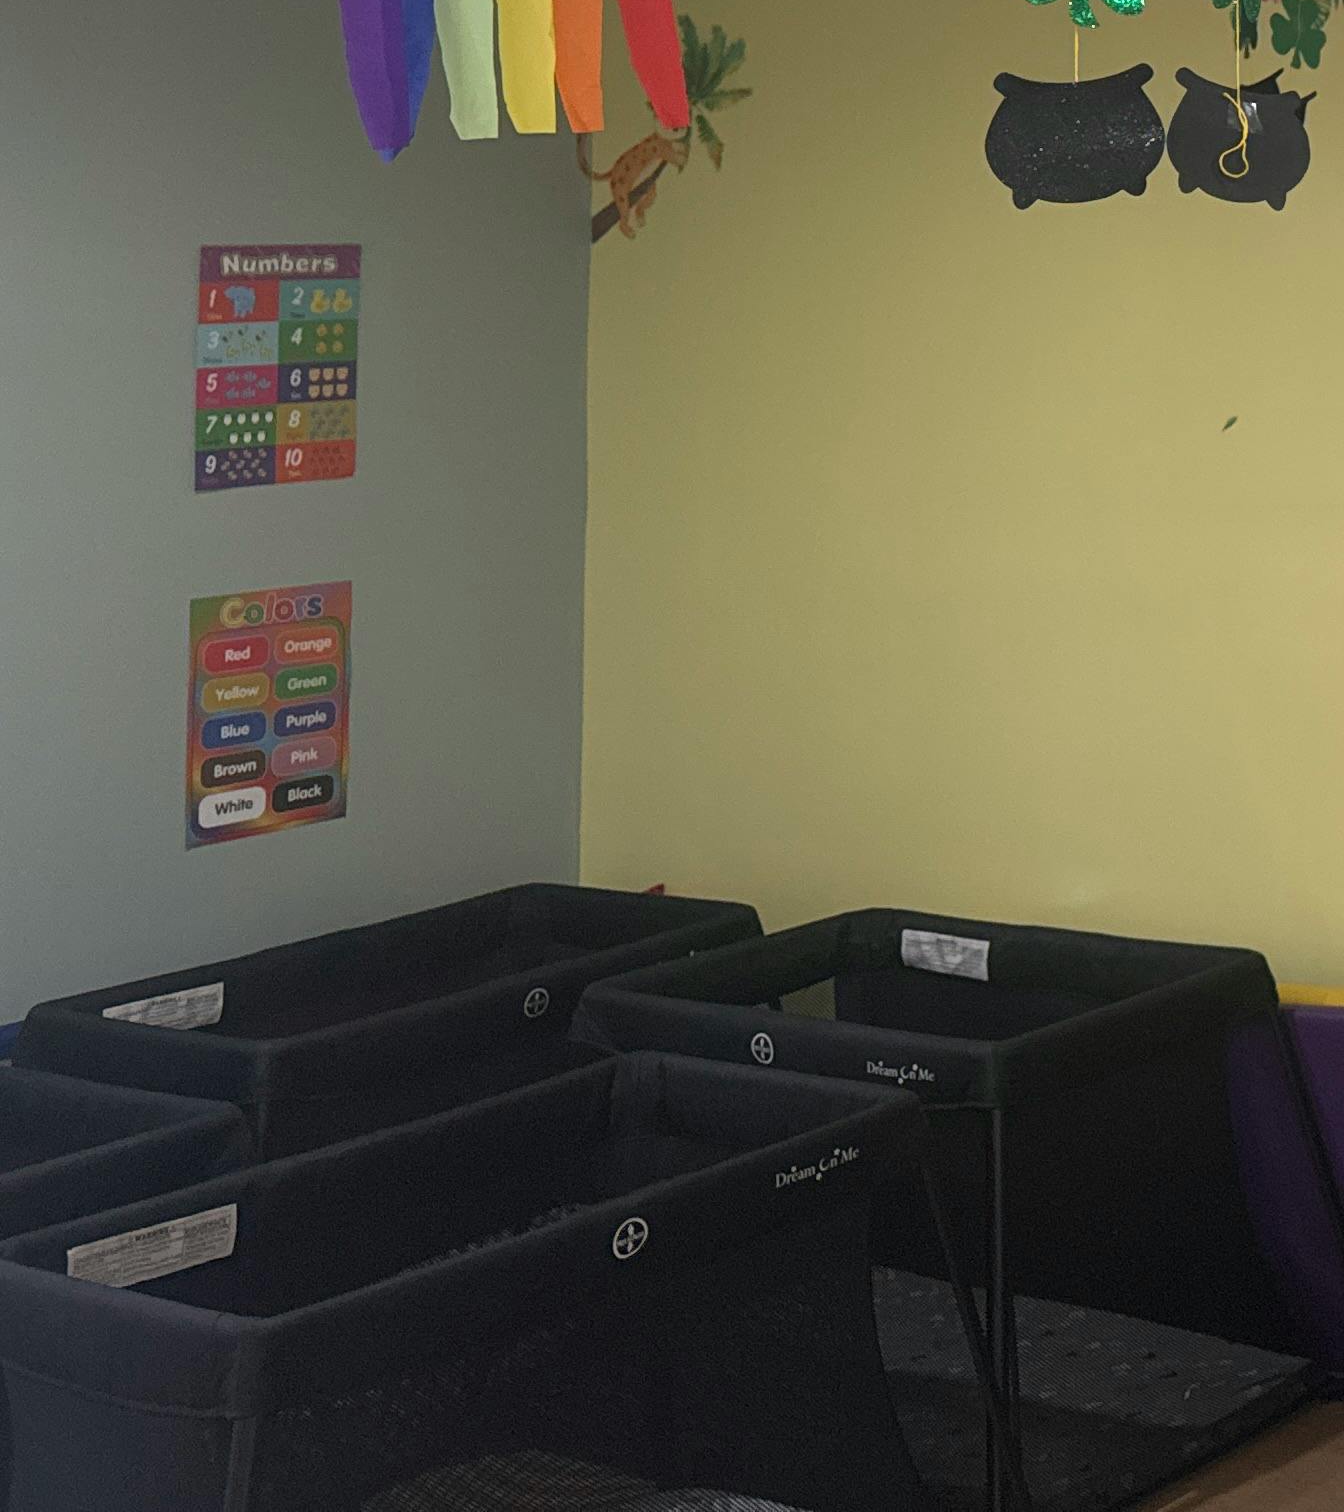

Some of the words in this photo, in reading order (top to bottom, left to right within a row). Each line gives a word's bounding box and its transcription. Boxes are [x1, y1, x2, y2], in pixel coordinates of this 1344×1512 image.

[222, 254, 337, 275] Numbers
[209, 289, 217, 309] 1
[291, 287, 304, 306] 2
[207, 331, 220, 350] 3
[291, 327, 303, 346] 4
[205, 372, 219, 393] 5
[290, 368, 302, 387] 6
[205, 415, 218, 434] 7
[288, 409, 301, 429] 8
[204, 455, 217, 475] 9
[284, 447, 303, 467] 10
[219, 592, 324, 629] Colors
[224, 645, 251, 663] Red
[284, 636, 332, 654] Orange
[287, 673, 328, 691] Green
[215, 684, 260, 702] Yellow
[285, 710, 328, 729] Purple
[220, 723, 250, 740] Blue
[290, 747, 319, 765] Pink
[213, 759, 257, 778] Brown
[287, 783, 322, 803] Black
[214, 797, 254, 816] White
[866, 1060, 898, 1078] Dream
[918, 1068, 936, 1082] Me
[775, 1165, 816, 1188] Dream
[840, 1146, 860, 1163] Me
